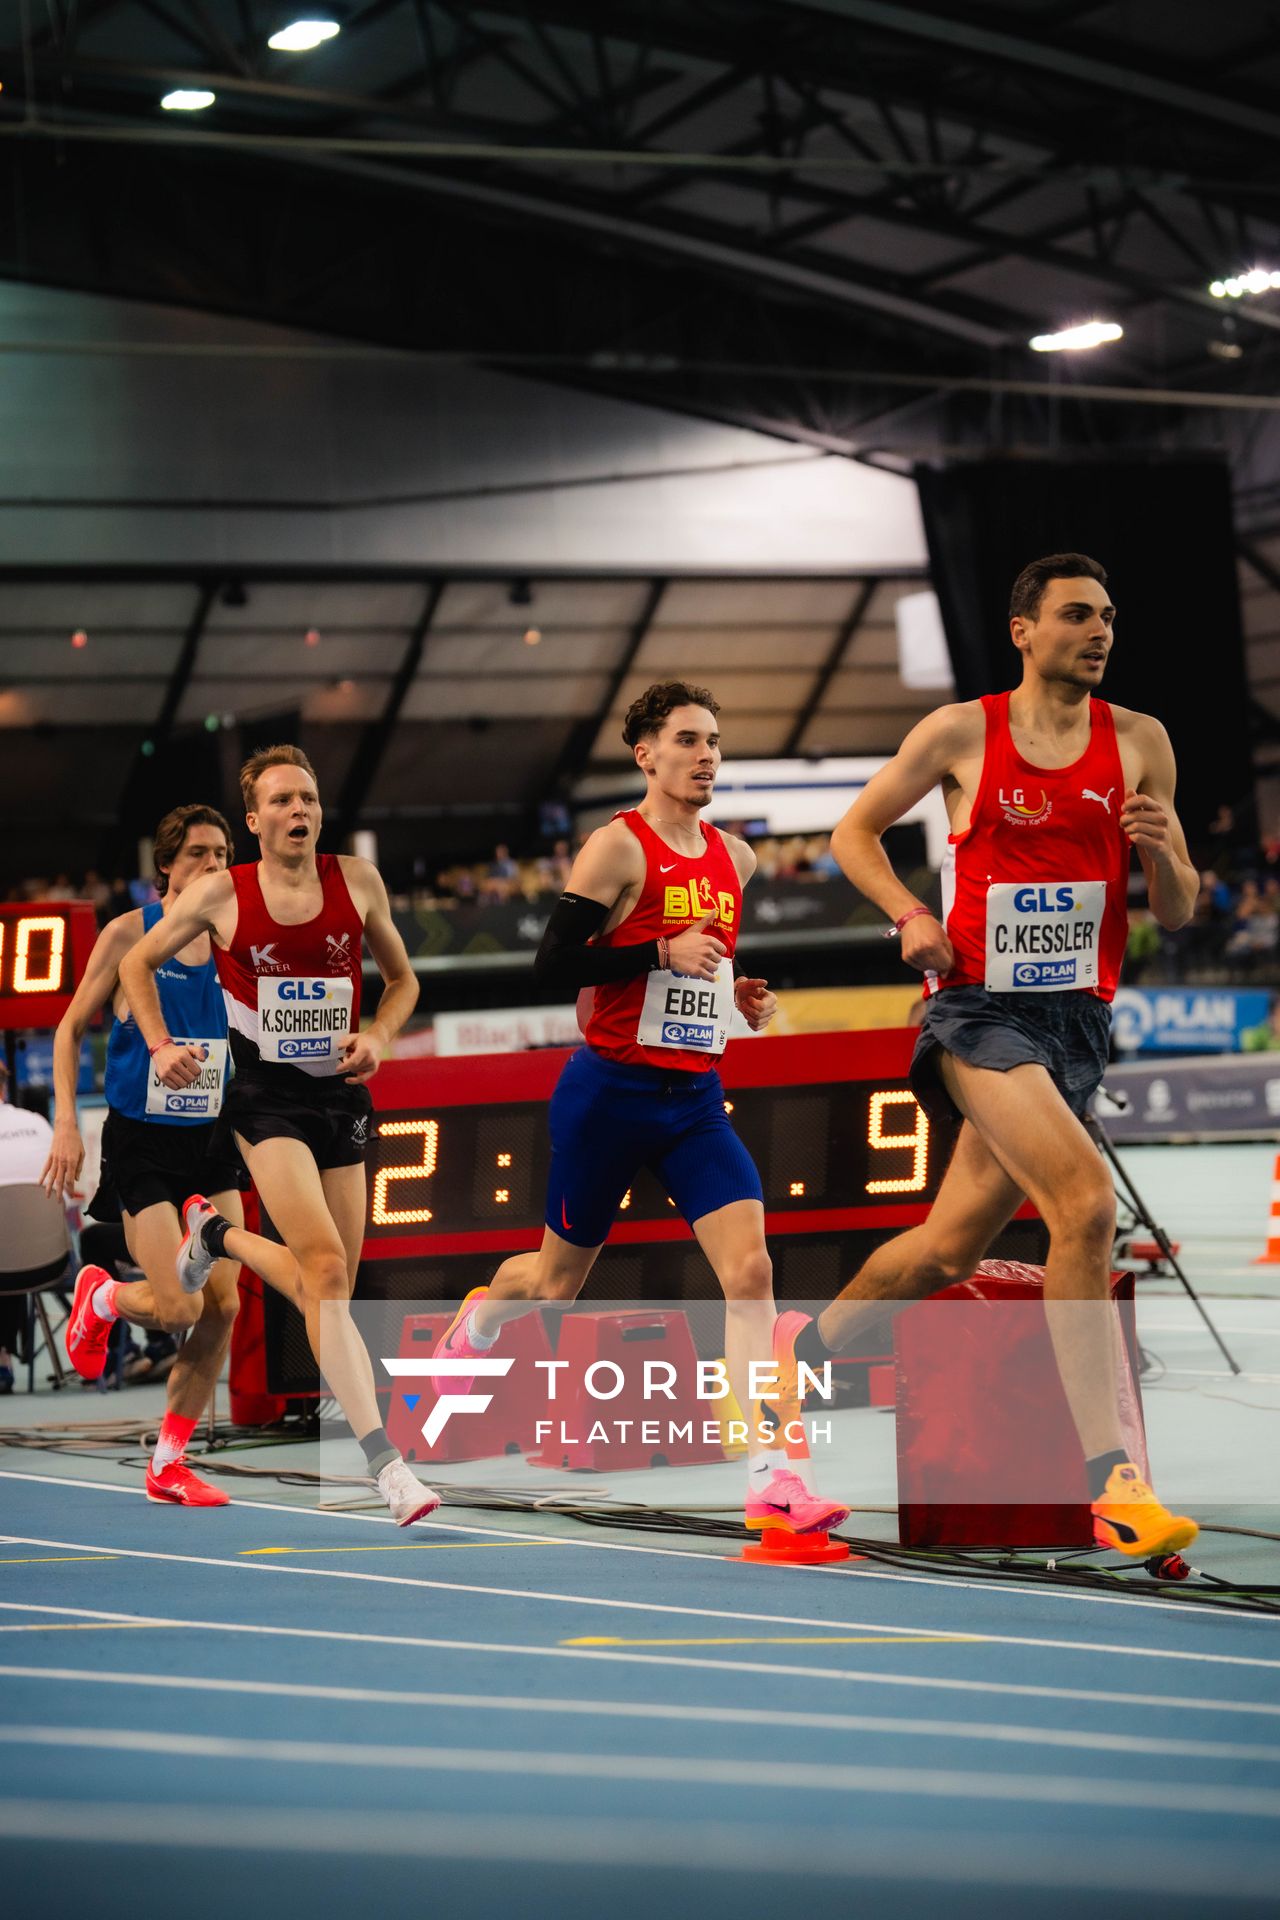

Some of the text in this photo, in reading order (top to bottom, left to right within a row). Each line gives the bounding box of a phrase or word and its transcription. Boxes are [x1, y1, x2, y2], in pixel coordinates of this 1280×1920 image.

[1004, 813, 1026, 826] Region
[995, 921, 1094, 954] C.KESSLER
[255, 963, 291, 973] KIEFER
[1041, 963, 1075, 977] PLAN
[166, 969, 188, 981] Rhede
[664, 987, 719, 1019] EBEL
[1155, 994, 1236, 1029] PLAN
[261, 1007, 348, 1033] K.SCHREINER
[686, 1027, 713, 1040] PLAN
[300, 1040, 330, 1051] PLAN
[185, 1097, 208, 1108] PLAN
